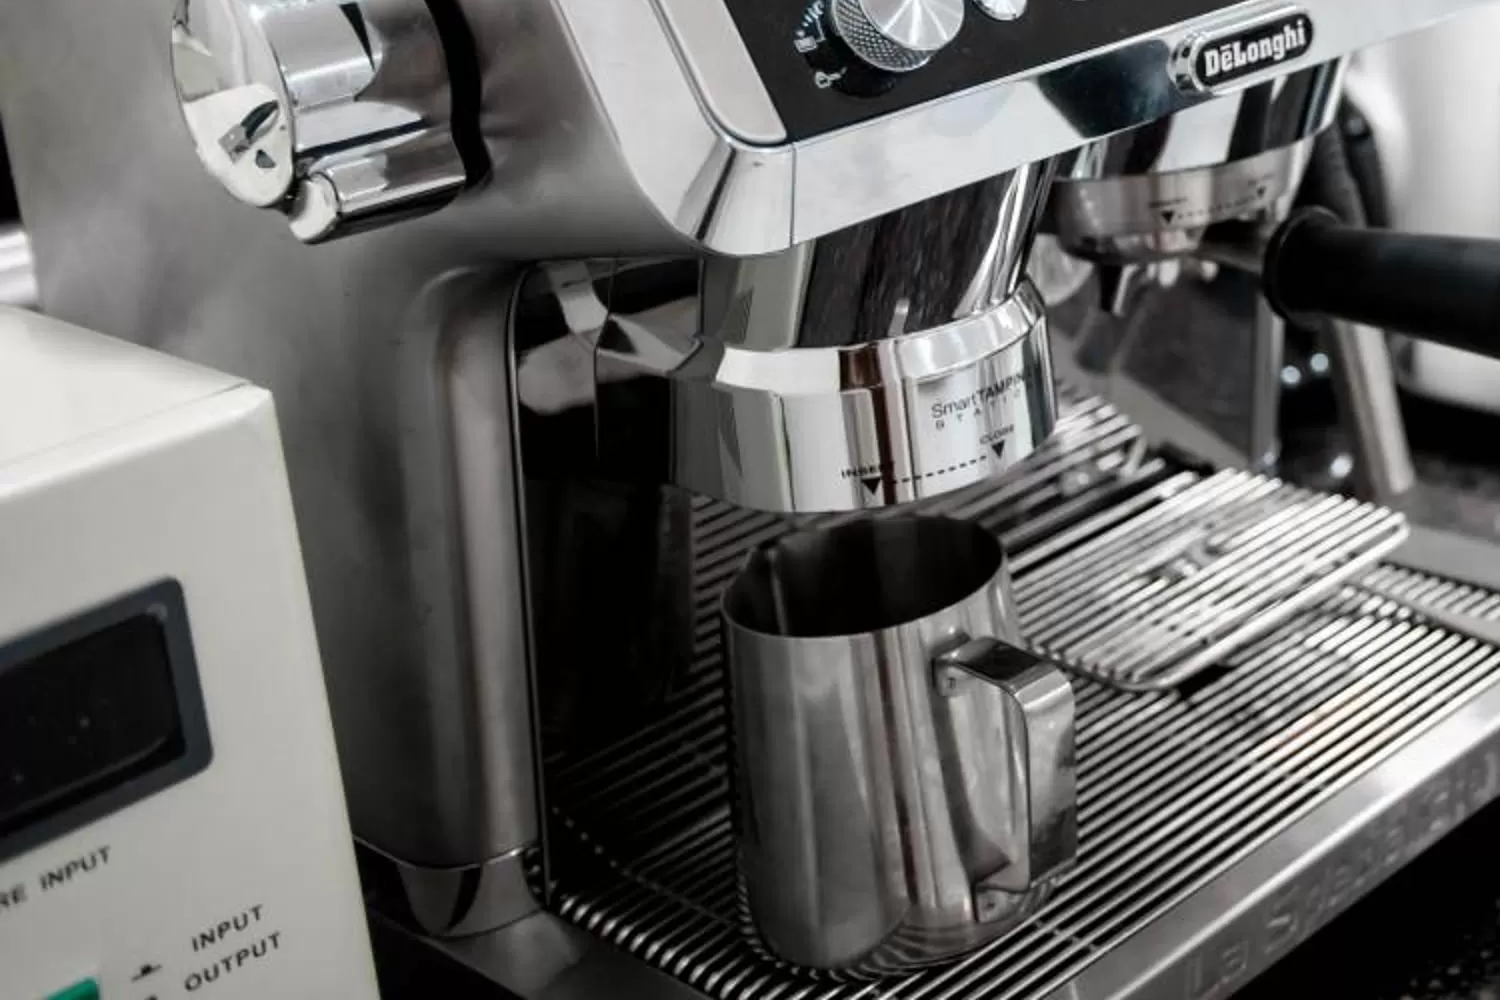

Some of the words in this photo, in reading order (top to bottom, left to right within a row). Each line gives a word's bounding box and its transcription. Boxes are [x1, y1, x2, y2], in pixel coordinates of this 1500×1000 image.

[39, 845, 111, 891] INPUT
[191, 903, 263, 953] INPUT
[183, 930, 281, 993] OUTPUT
